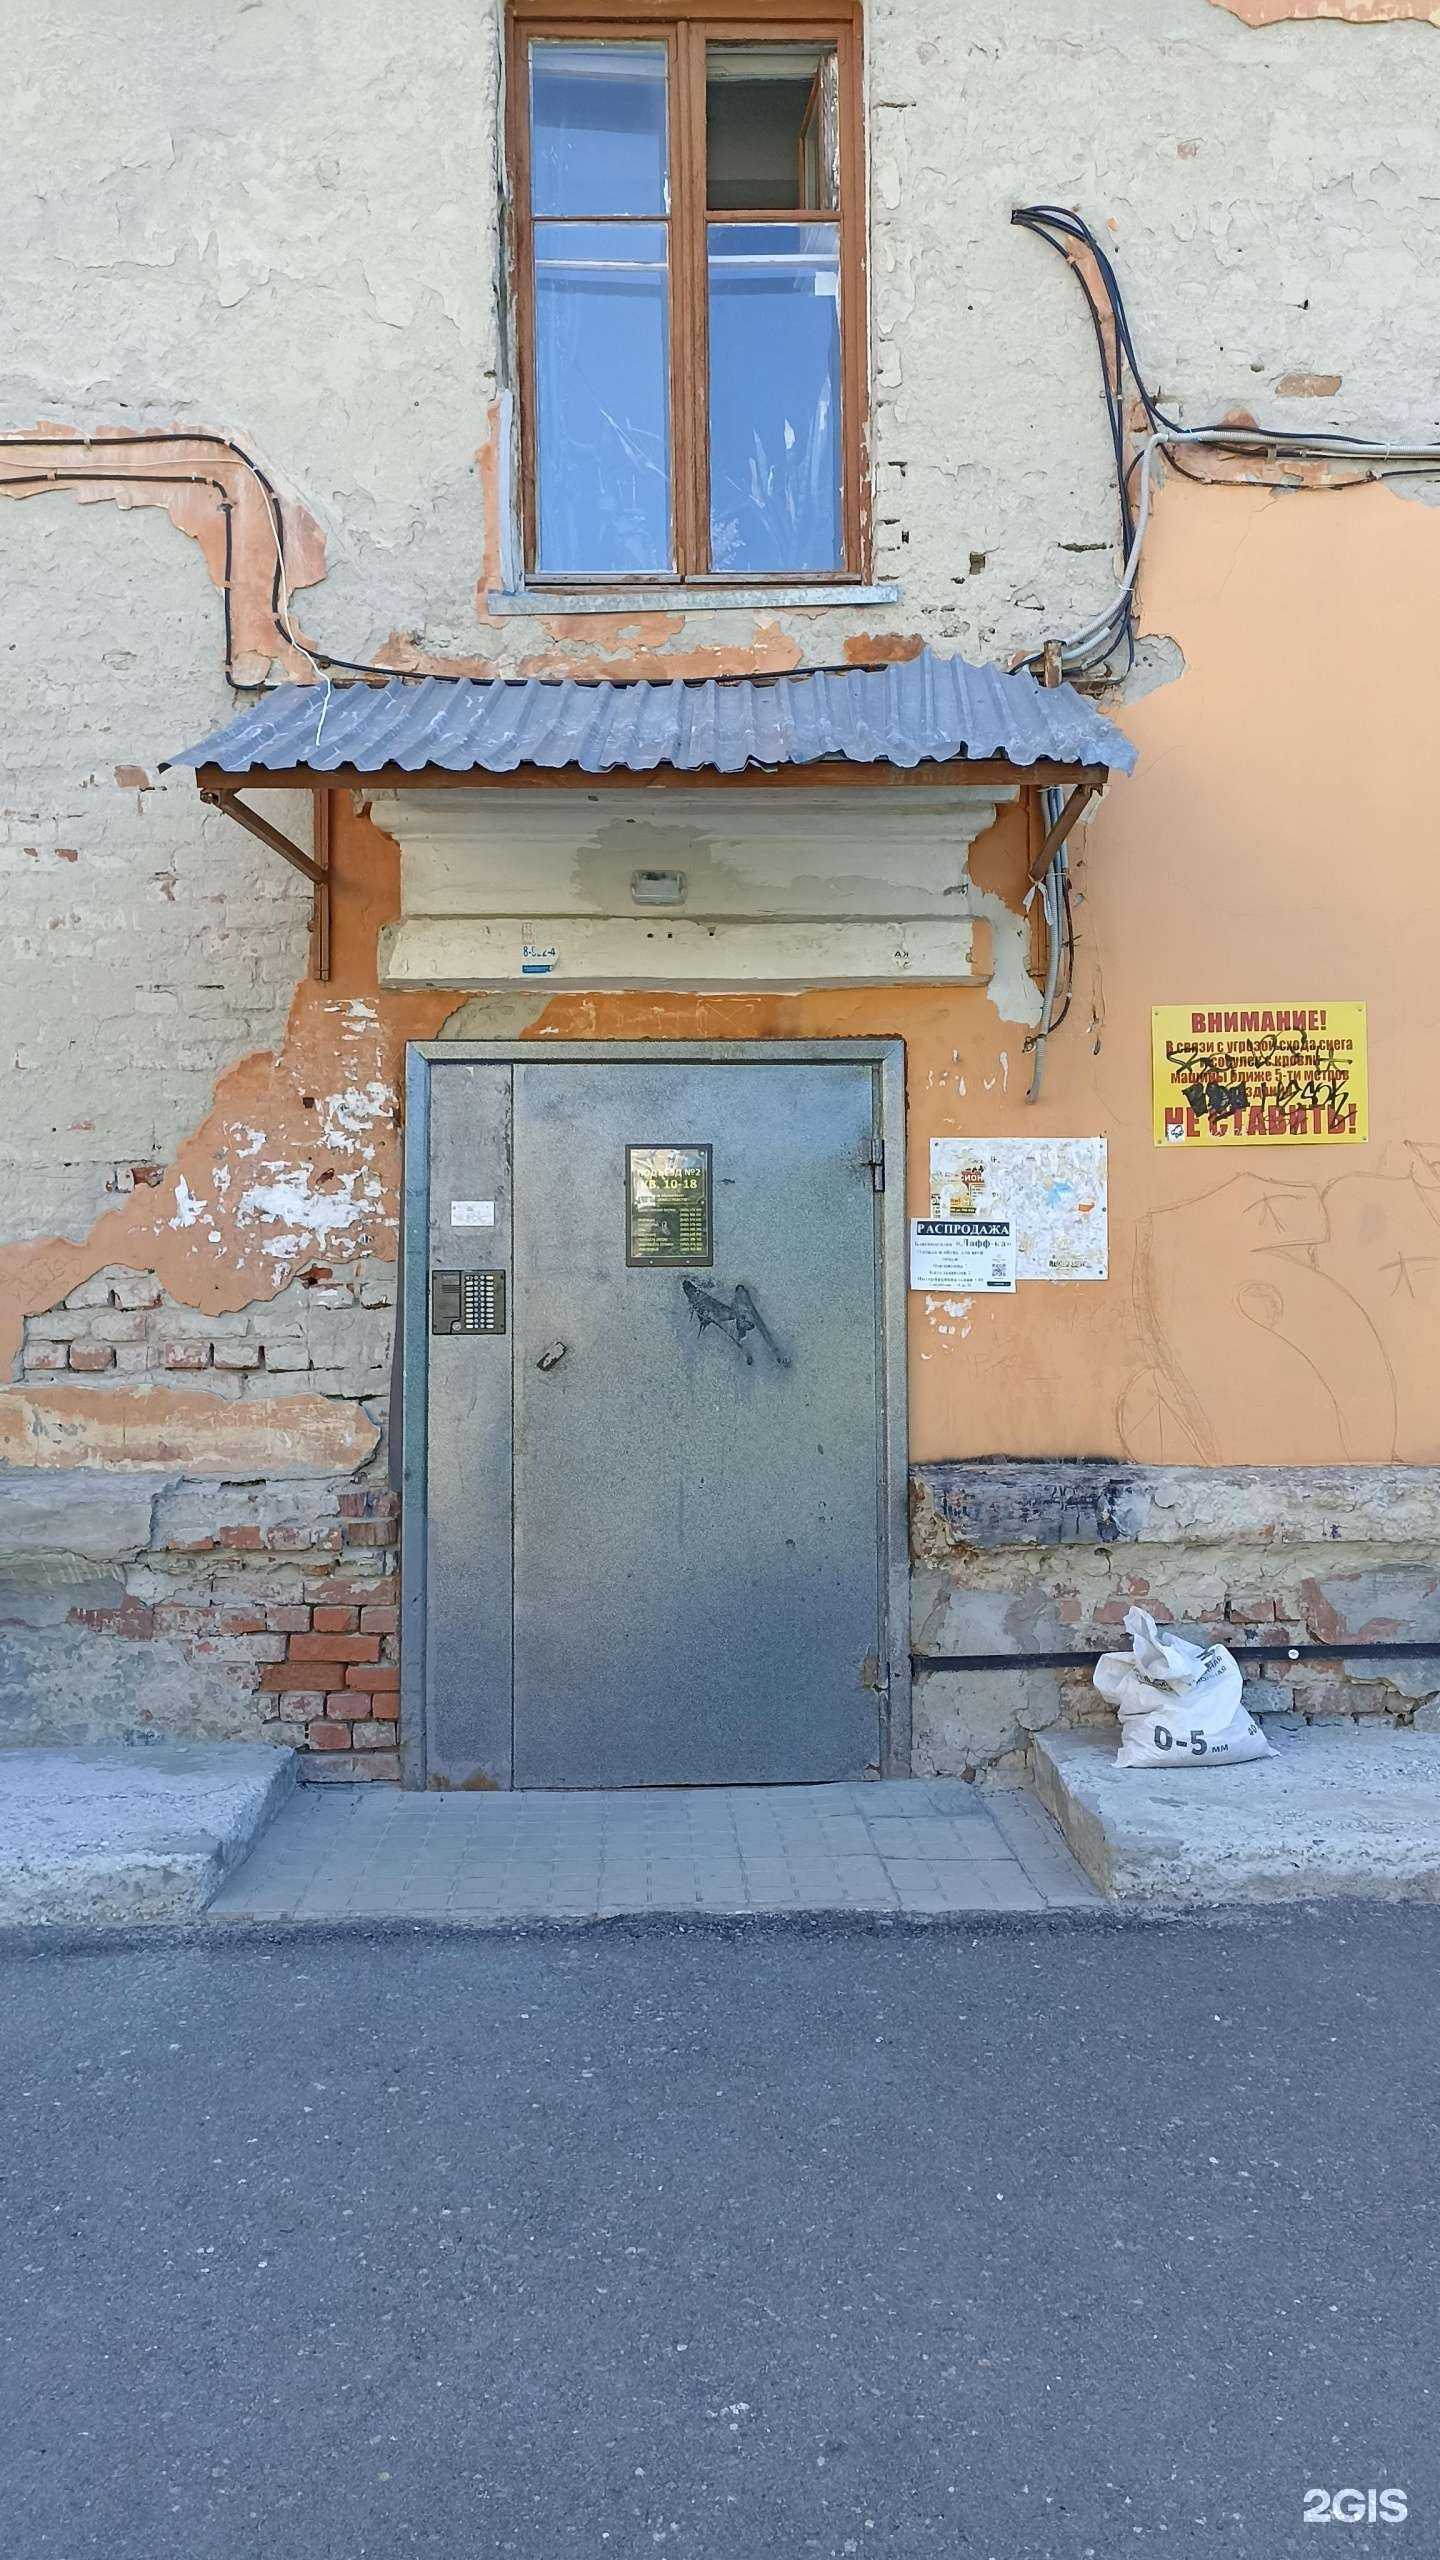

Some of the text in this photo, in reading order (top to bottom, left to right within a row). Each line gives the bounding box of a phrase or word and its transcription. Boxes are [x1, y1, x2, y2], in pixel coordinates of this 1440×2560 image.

[1191, 1009, 1327, 1033] ВНИМАНИЕ!
[1176, 1041, 1215, 1054] связи
[1216, 1041, 1224, 1052] с
[1319, 1037, 1353, 1051] снега
[1230, 1069, 1273, 1083] ближе
[1275, 1068, 1301, 1081] 5-ти
[1304, 1067, 1349, 1082] метров
[1164, 1102, 1358, 1138] НЕ СТАВИТЬ!
[684, 1168, 701, 1176] №2
[663, 1179, 698, 1189] 10-18
[917, 1222, 1009, 1236] РАСПРОДАЖА
[1154, 1725, 1207, 1755] 0-5
